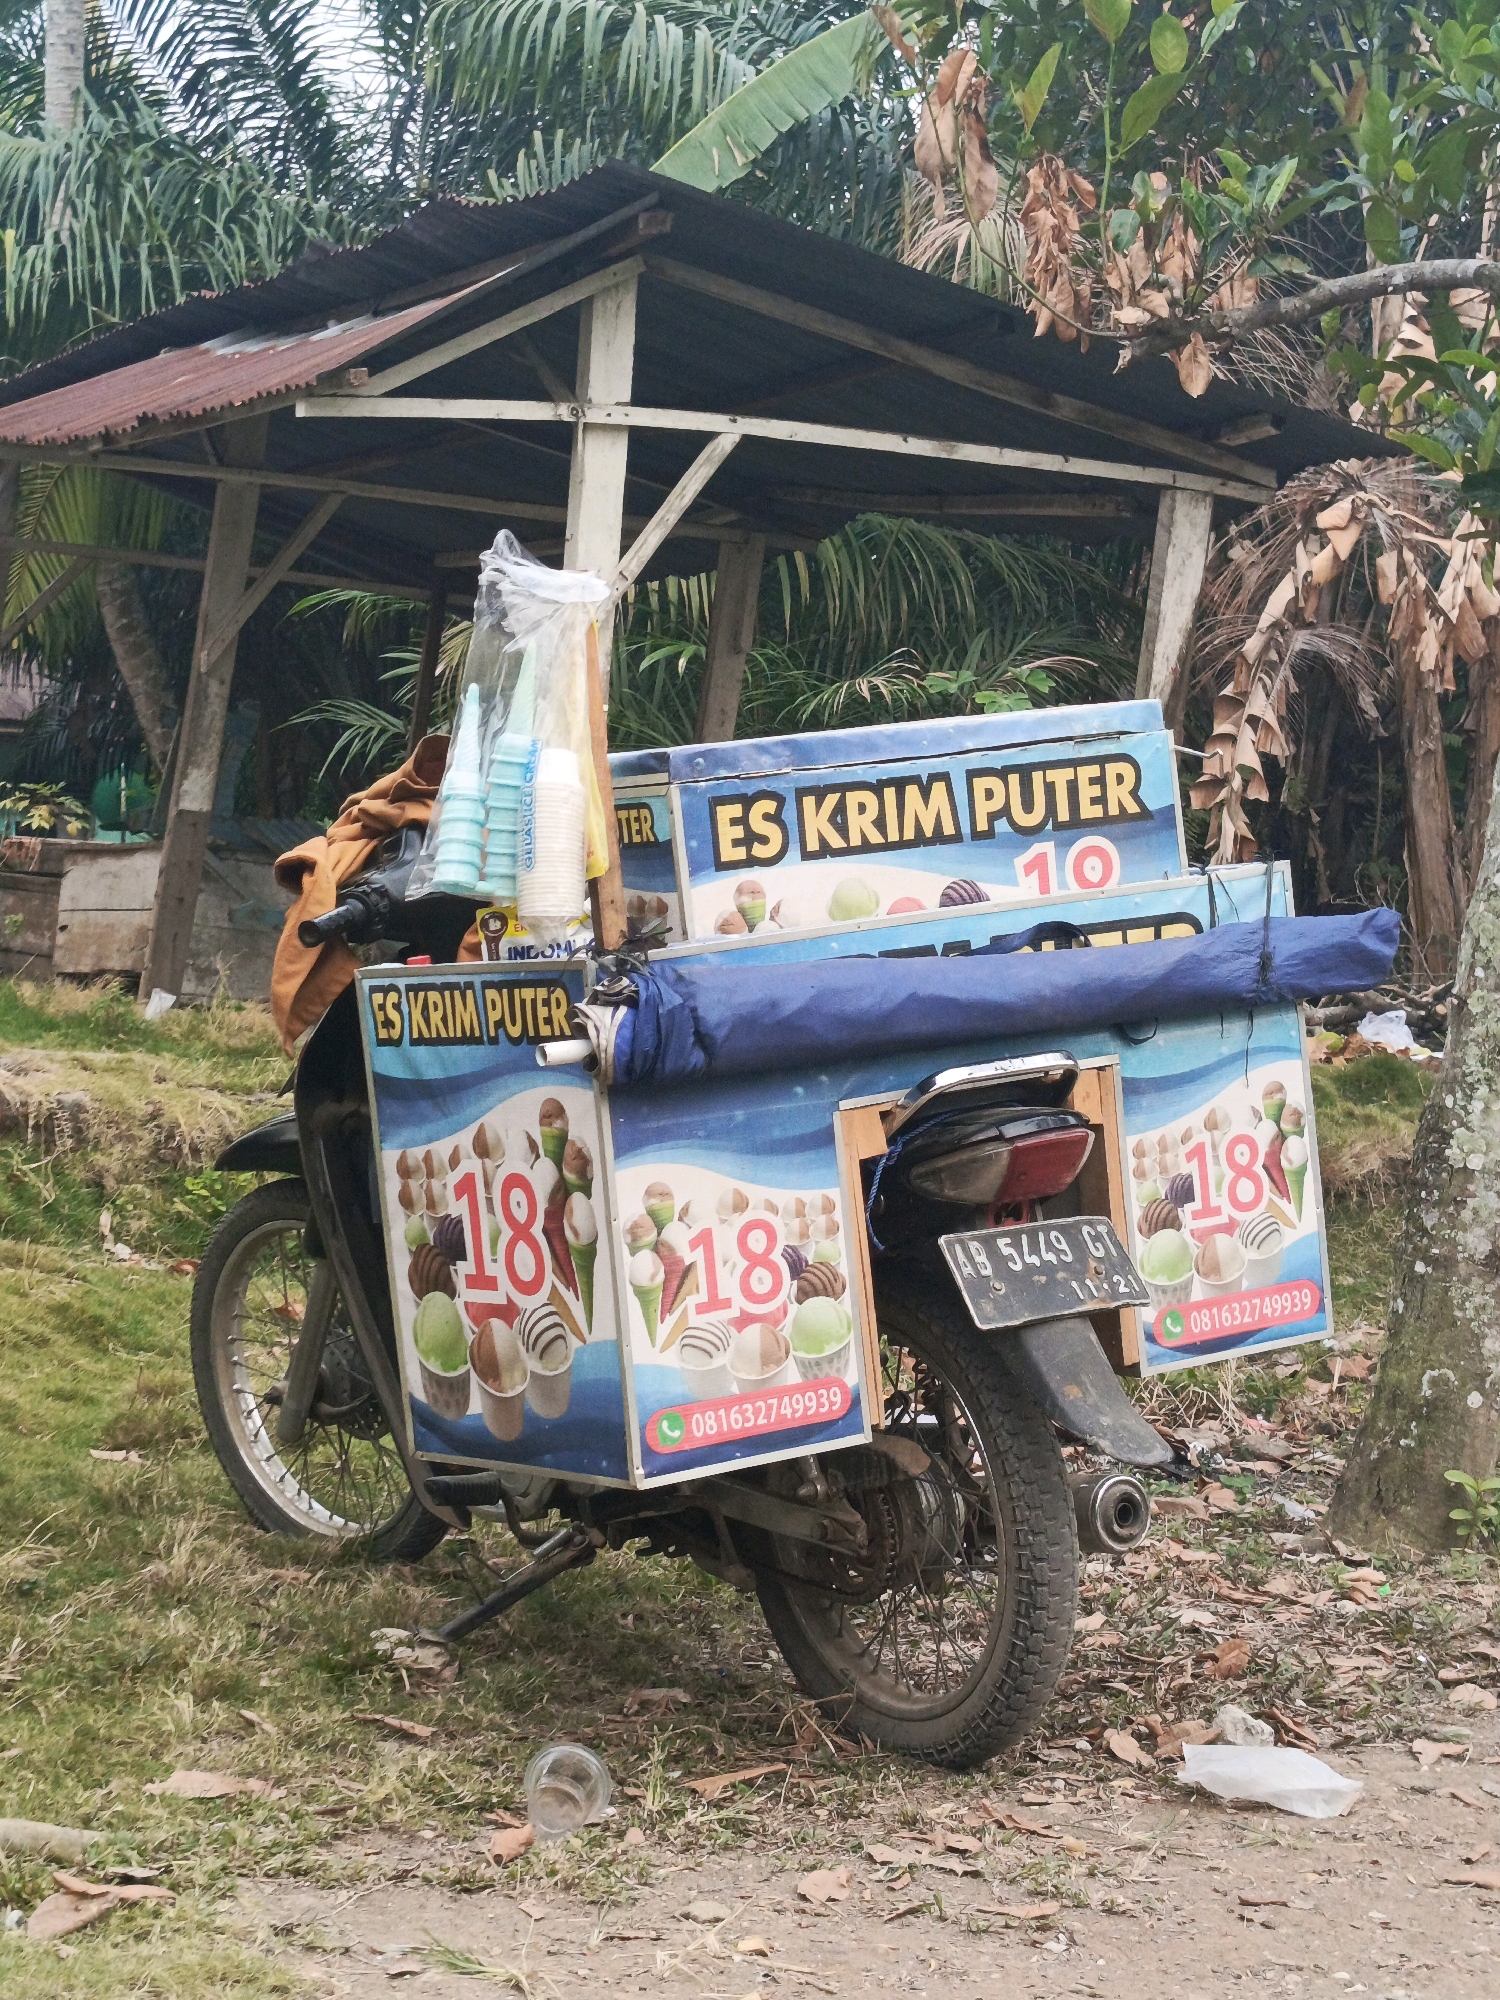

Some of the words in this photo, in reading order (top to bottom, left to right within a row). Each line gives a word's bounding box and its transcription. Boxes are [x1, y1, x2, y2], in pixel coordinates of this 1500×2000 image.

[714, 797, 784, 863] ES
[802, 775, 957, 853] KRIM
[973, 760, 1143, 832] PUTER
[371, 991, 402, 1040] ES
[408, 988, 481, 1039] KRIM
[484, 987, 573, 1038] PUTER
[1184, 1133, 1265, 1223] 18
[453, 1171, 546, 1296] 18
[688, 1218, 784, 1316] 18
[954, 1240, 993, 1280] AB
[996, 1230, 1073, 1272] 5449
[1190, 1288, 1312, 1334] 081632749939
[691, 1386, 842, 1438] 081632749939
